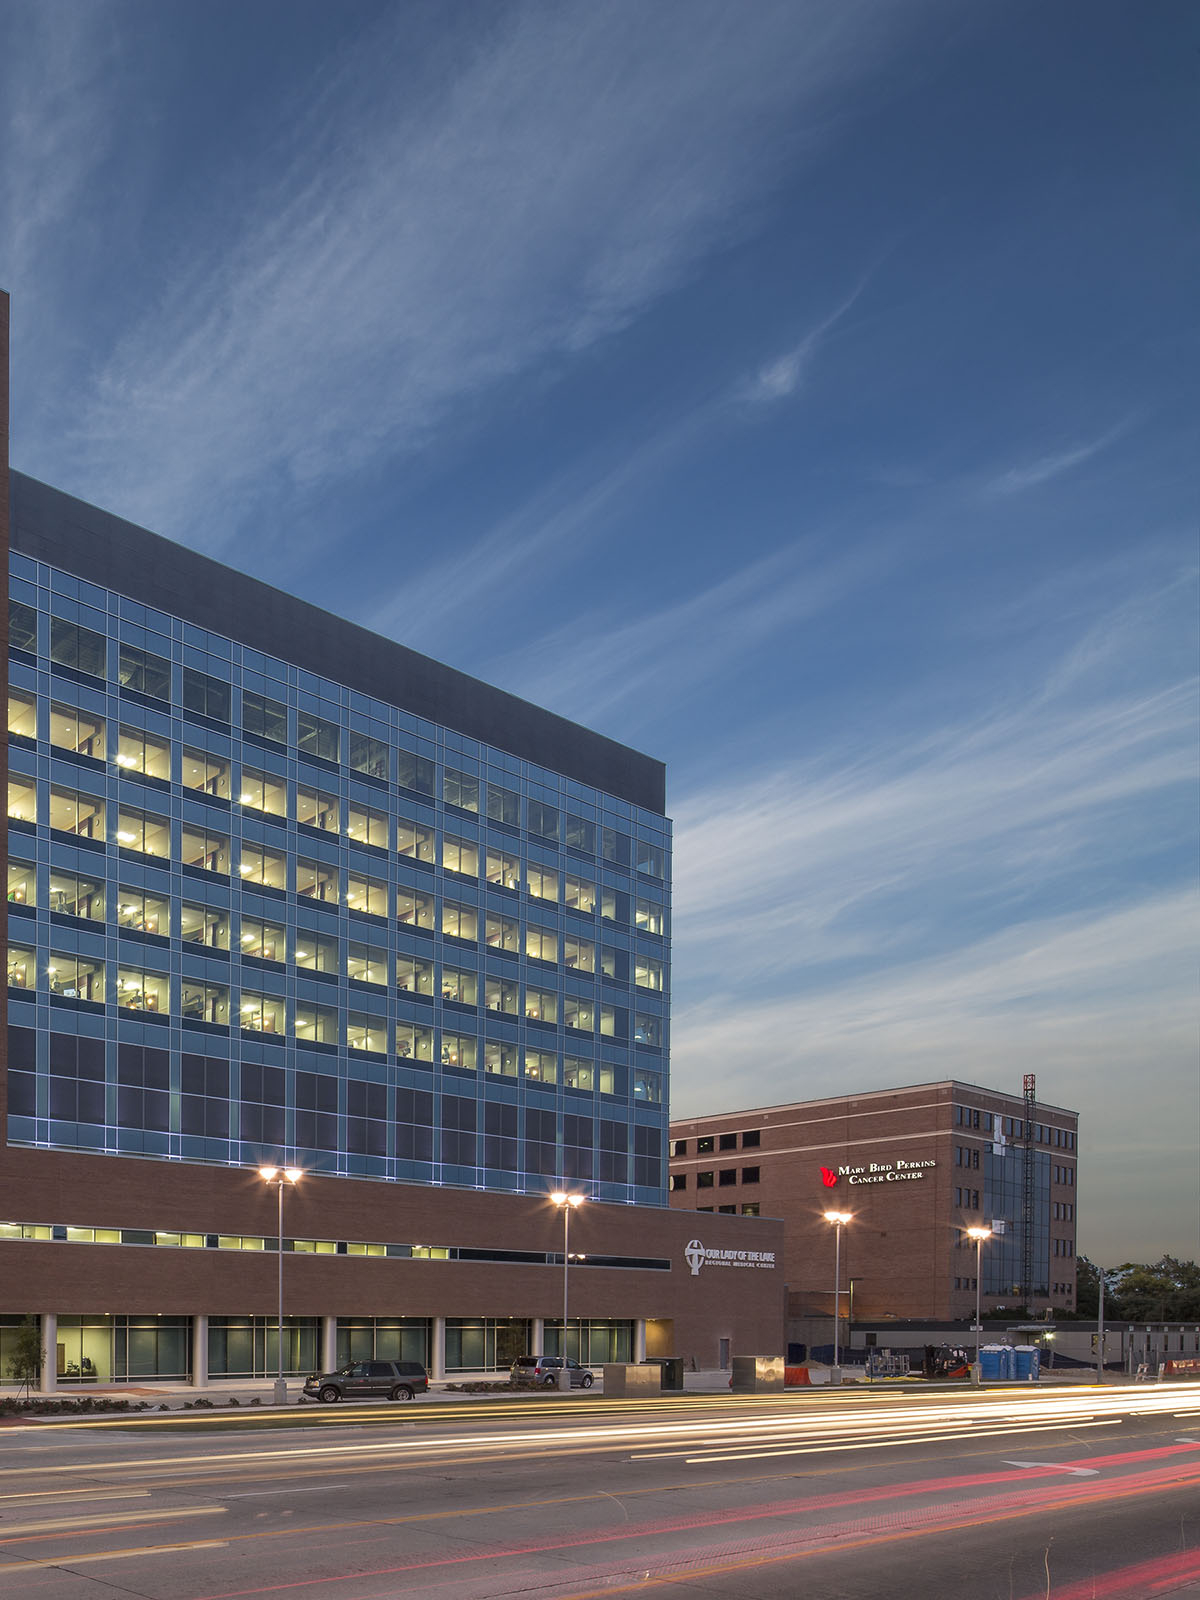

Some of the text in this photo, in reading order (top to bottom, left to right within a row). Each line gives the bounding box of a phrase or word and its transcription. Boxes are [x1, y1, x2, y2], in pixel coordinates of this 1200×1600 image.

[705, 1249, 775, 1262] OUR LADY OF THE LAKE
